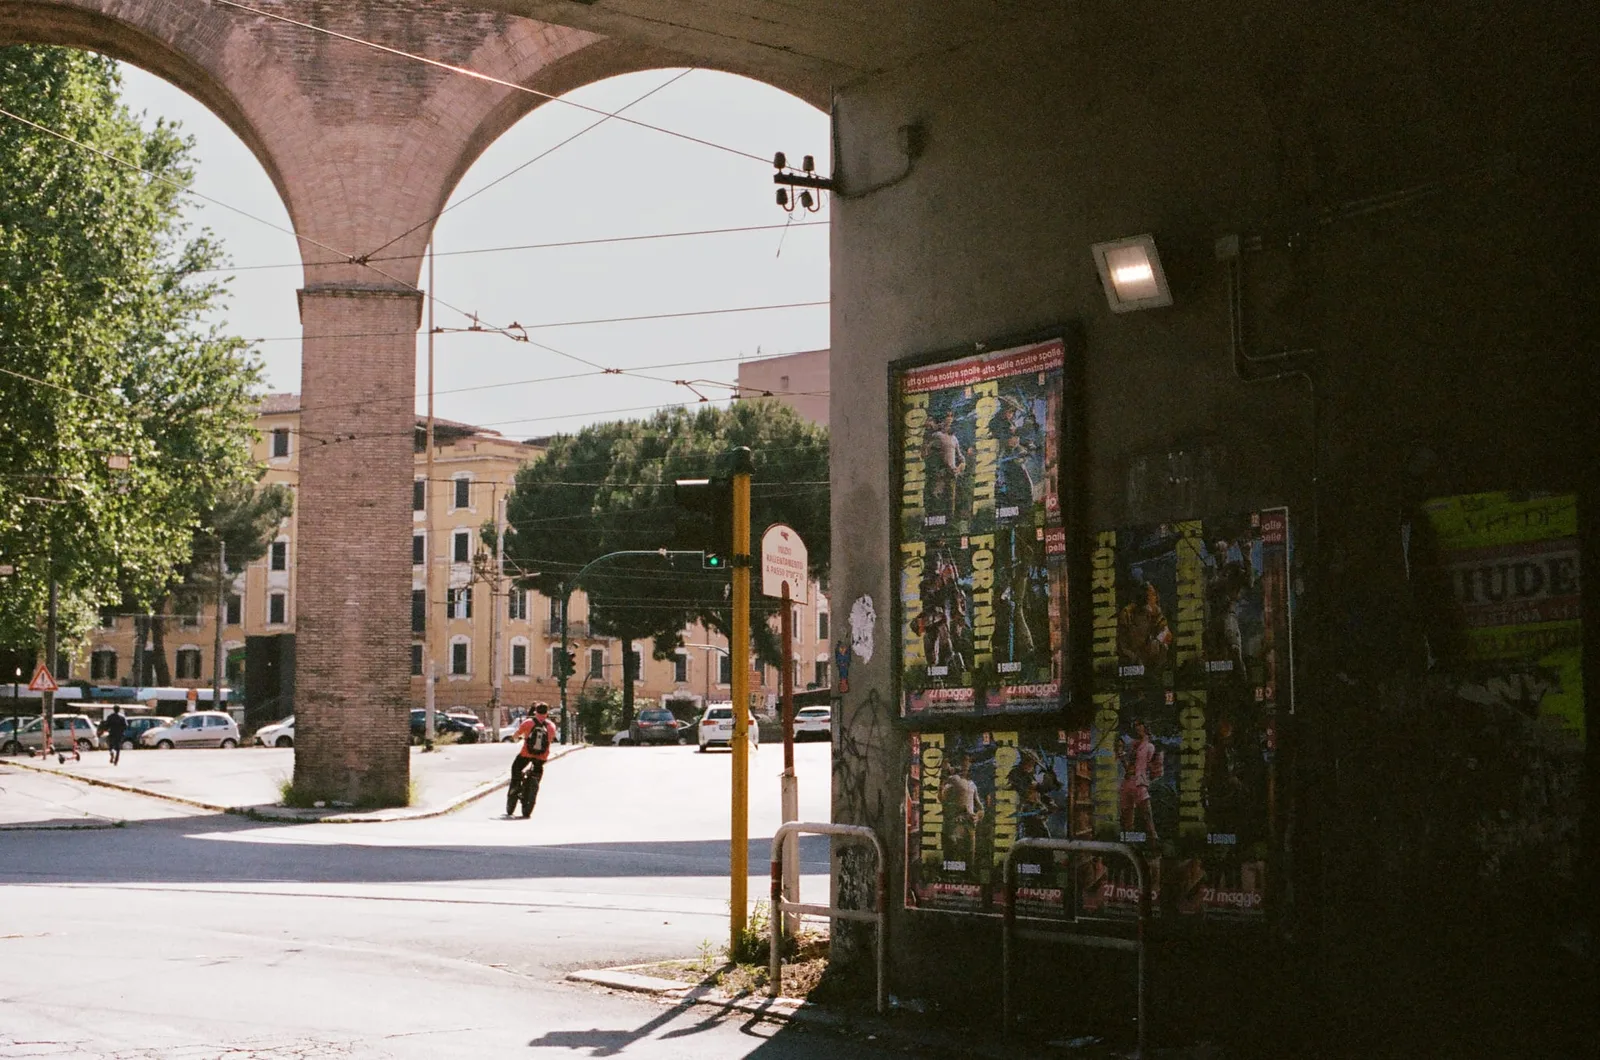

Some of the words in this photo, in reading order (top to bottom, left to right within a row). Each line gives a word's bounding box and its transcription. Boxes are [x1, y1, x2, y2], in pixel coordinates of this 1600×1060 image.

[1015, 355, 1037, 366] nostre
[902, 393, 930, 519] FORTNITE
[972, 380, 999, 515] FORTNITE
[970, 534, 995, 668] FORTNITE
[1092, 531, 1119, 671] FORTNITE
[1018, 683, 1058, 696] maggio
[920, 733, 945, 863] FORTNITE
[1176, 690, 1208, 837] FORTNITE
[1103, 884, 1114, 898] 27
[1203, 888, 1215, 902] 27
[1216, 890, 1262, 908] maggio
